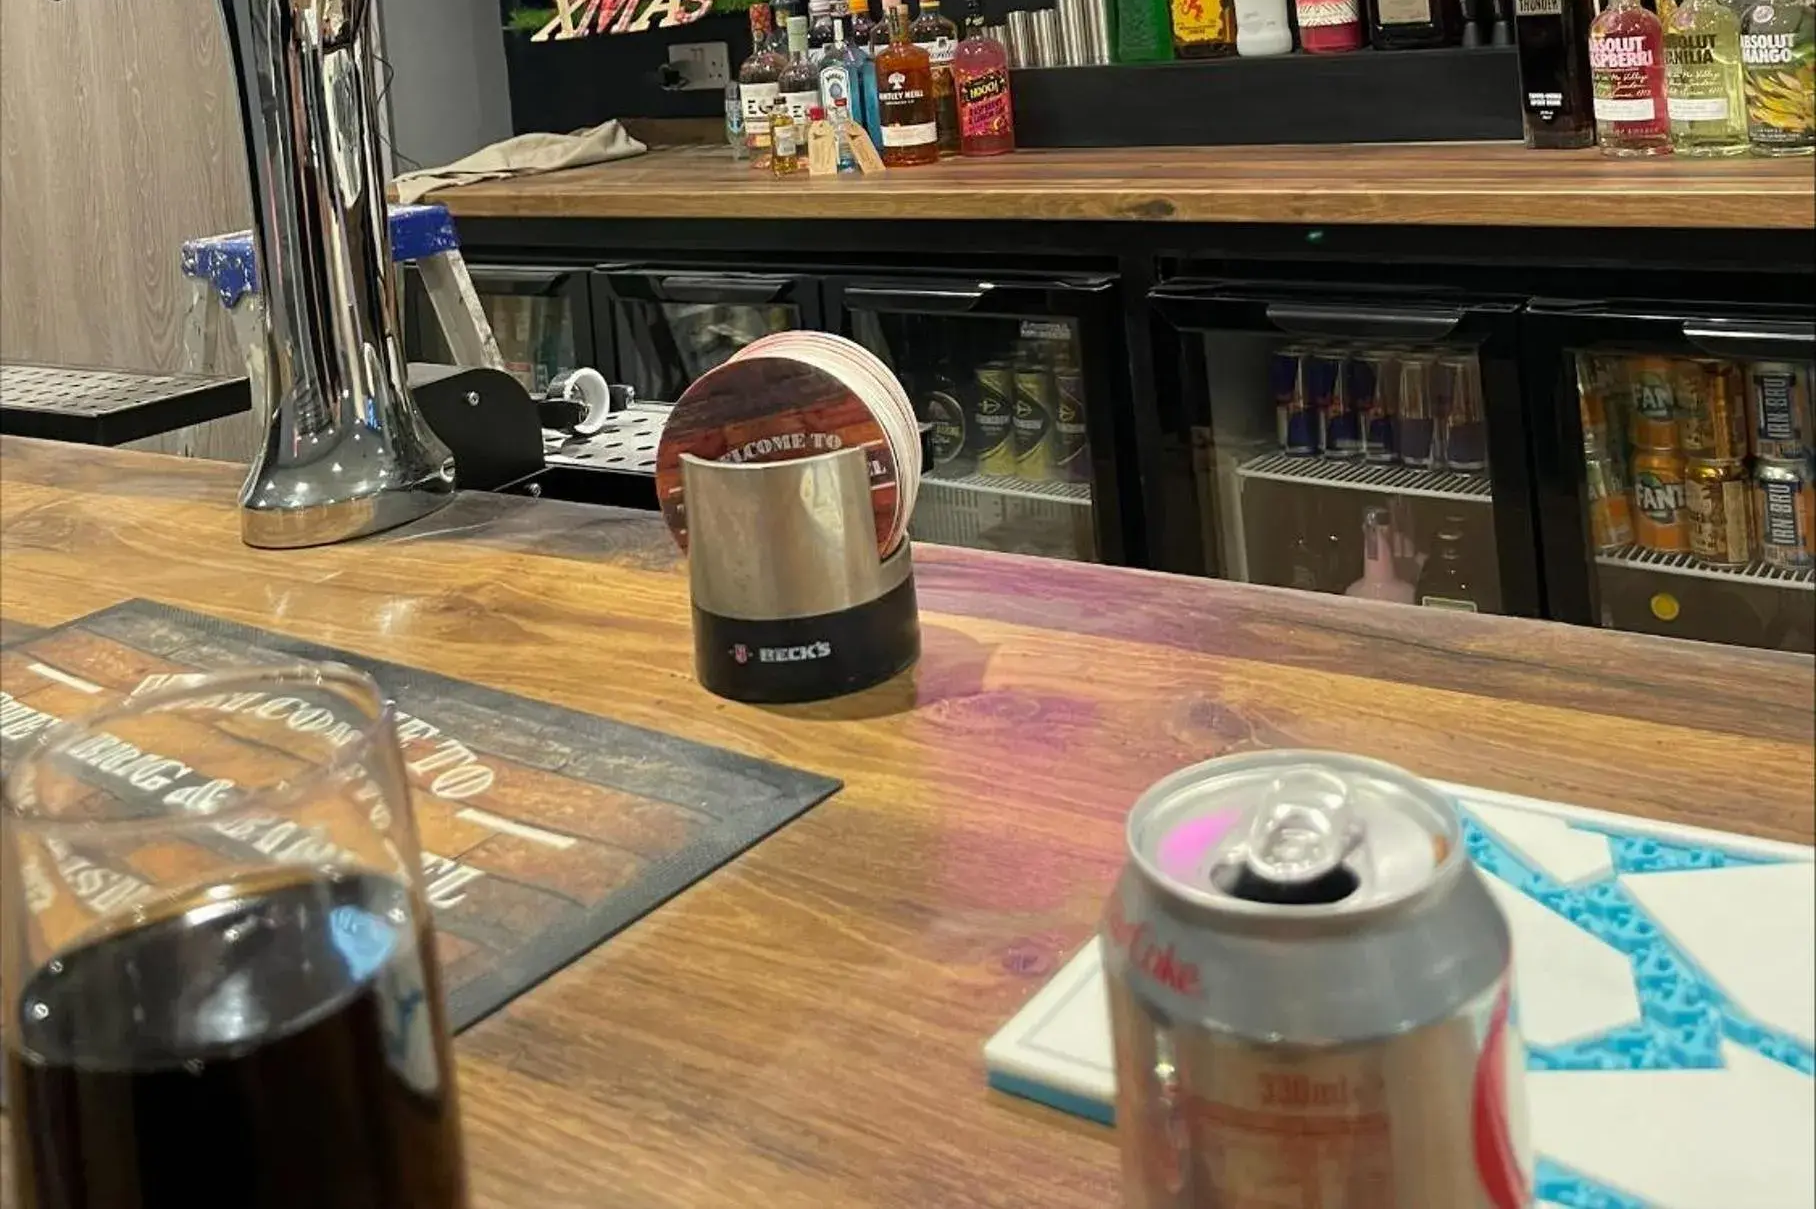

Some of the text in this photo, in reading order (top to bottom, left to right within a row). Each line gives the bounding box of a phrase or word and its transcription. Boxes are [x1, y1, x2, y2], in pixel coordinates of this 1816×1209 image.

[811, 433, 842, 451] TO
[1634, 480, 1687, 511] FANT
[759, 641, 832, 663] BECK'S
[405, 738, 495, 799] TO
